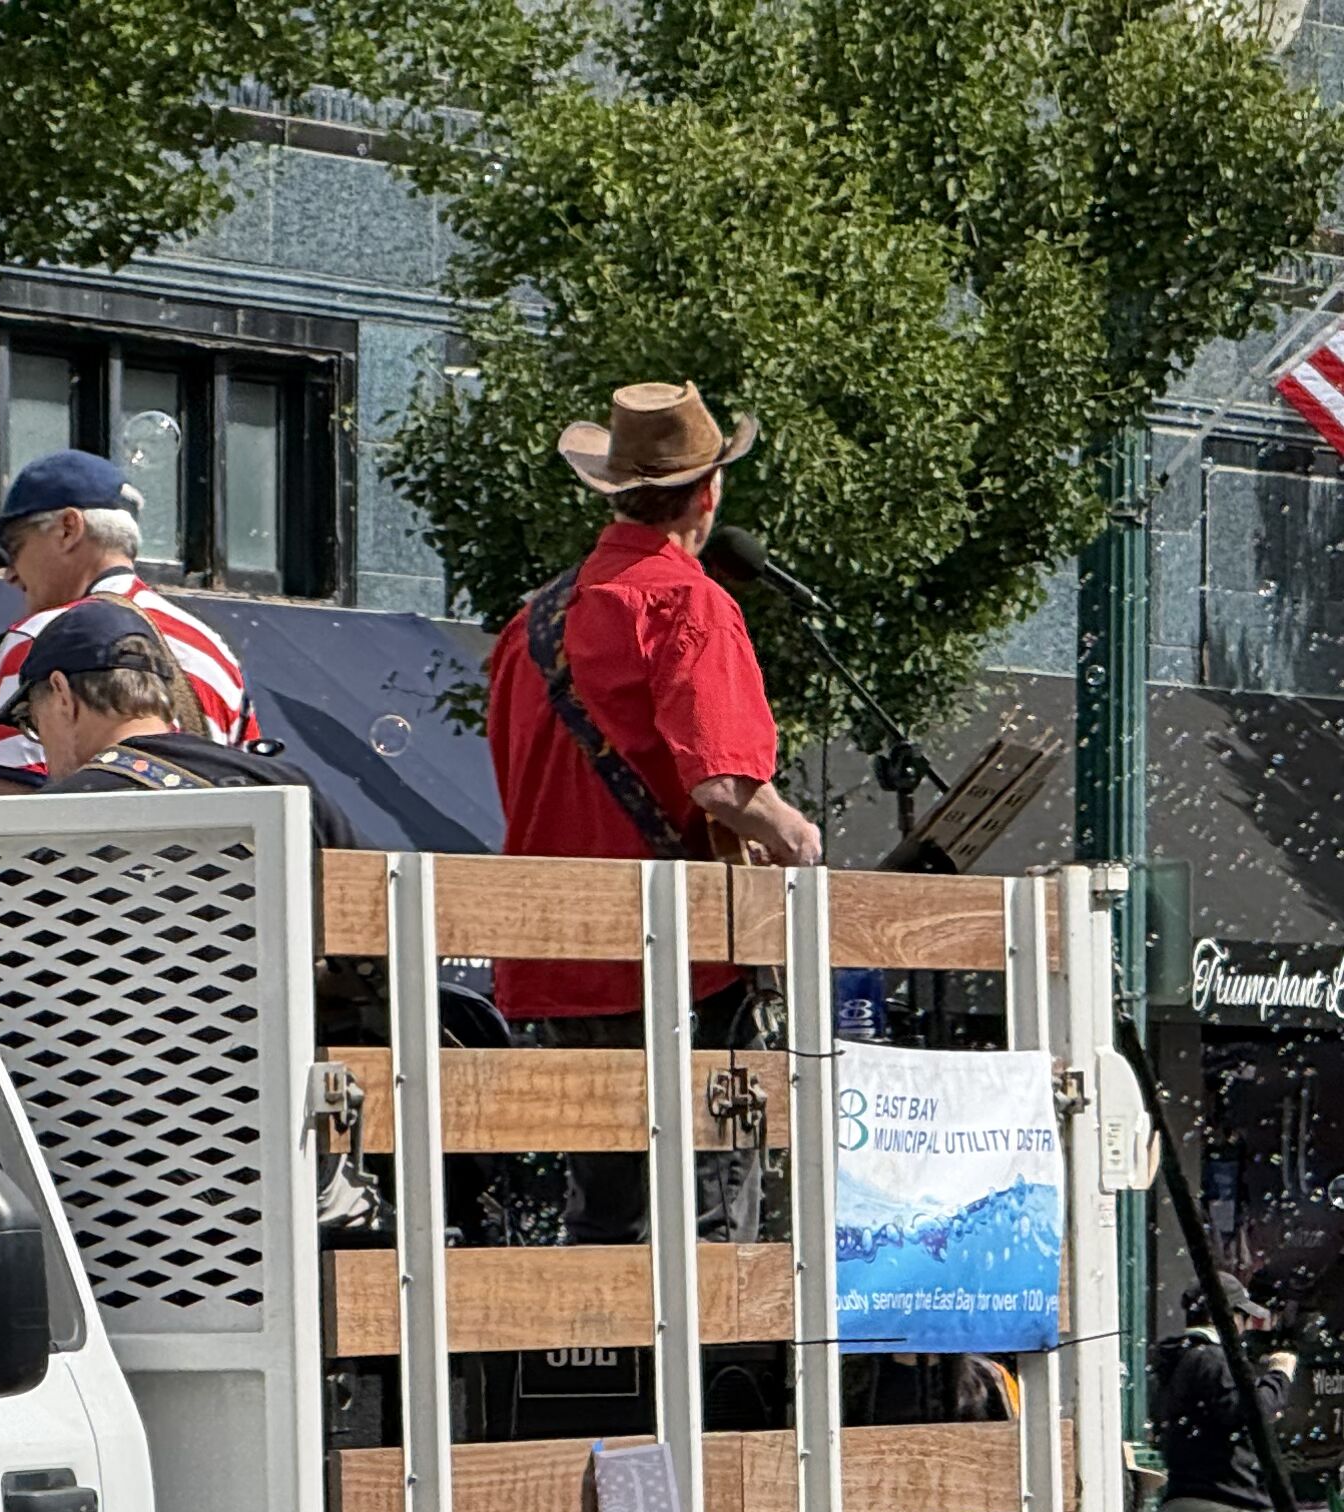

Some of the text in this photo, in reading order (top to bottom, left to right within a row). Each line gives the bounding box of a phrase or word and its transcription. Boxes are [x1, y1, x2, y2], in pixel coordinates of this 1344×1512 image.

[1193, 937, 1326, 1022] Triumphant
[875, 1094, 940, 1122] EAST BAY
[874, 1128, 941, 1154] MUNICIPAL
[945, 1128, 1010, 1154] UTILITY
[872, 1291, 913, 1316] serving
[915, 1288, 933, 1311] the
[933, 1286, 956, 1311] East
[955, 1287, 976, 1315] Bay
[976, 1289, 992, 1312] for
[992, 1292, 1019, 1312] over
[1022, 1288, 1044, 1312] 100
